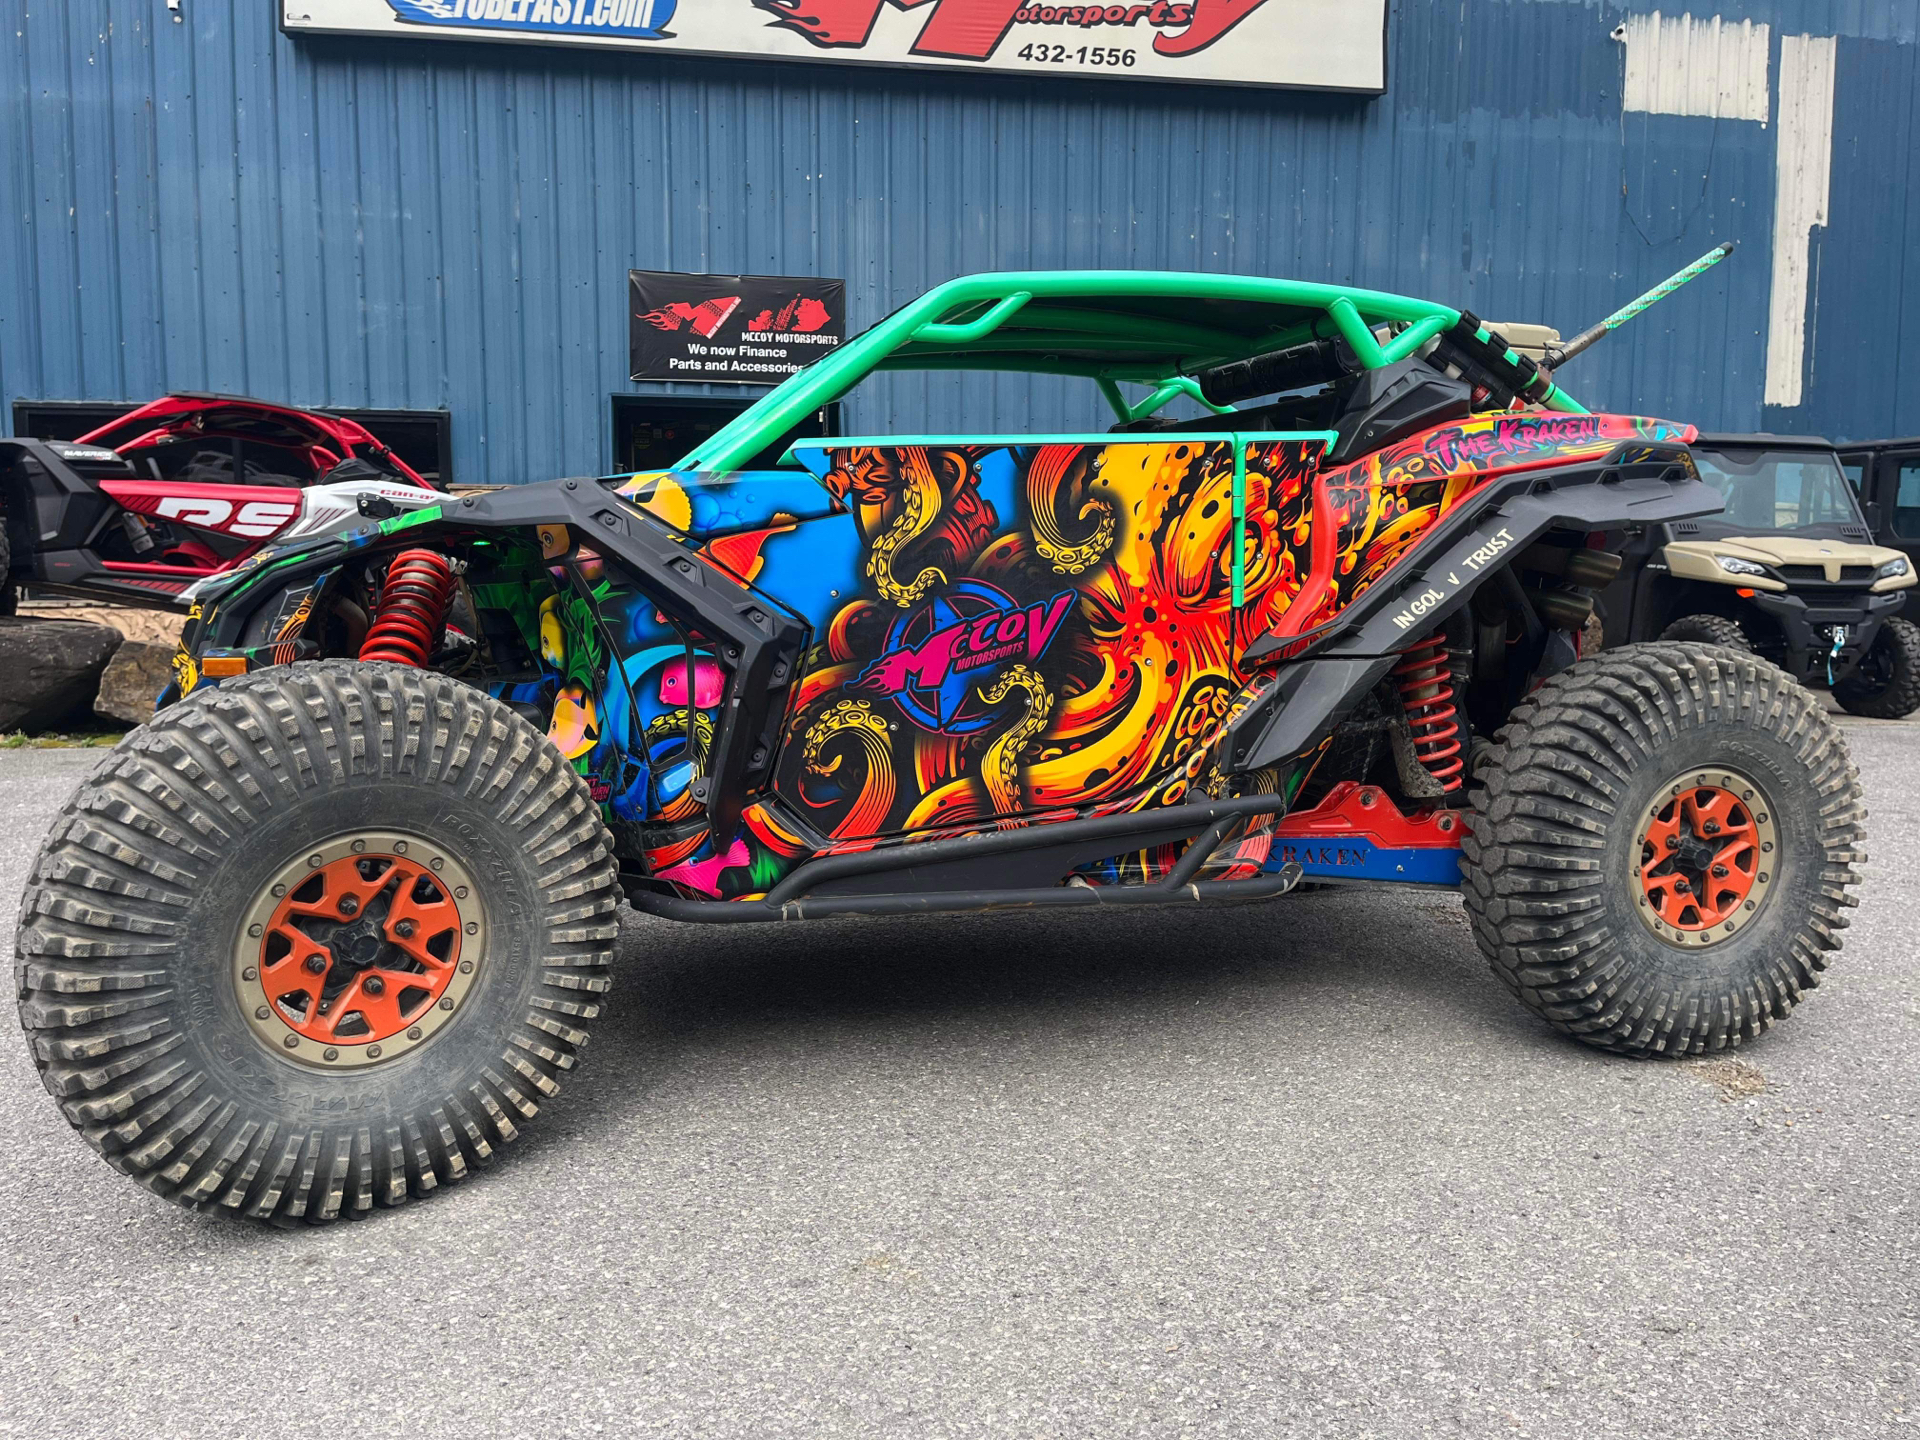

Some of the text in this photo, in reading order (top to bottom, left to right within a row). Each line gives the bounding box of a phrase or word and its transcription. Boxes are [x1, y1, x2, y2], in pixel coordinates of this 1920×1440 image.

[1018, 43, 1137, 67] 432-1556
[741, 332, 839, 345] MCCOY MOTORSPORTS
[688, 343, 788, 358] We now Finance
[669, 358, 702, 370] Parts
[704, 361, 728, 371] and
[1429, 418, 1595, 468] THE KRAKEN
[1447, 571, 1460, 585] V
[1461, 527, 1515, 571] TRUST
[955, 640, 1025, 671] MOTORSPORTS
[1268, 845, 1368, 867] KRAKEN
